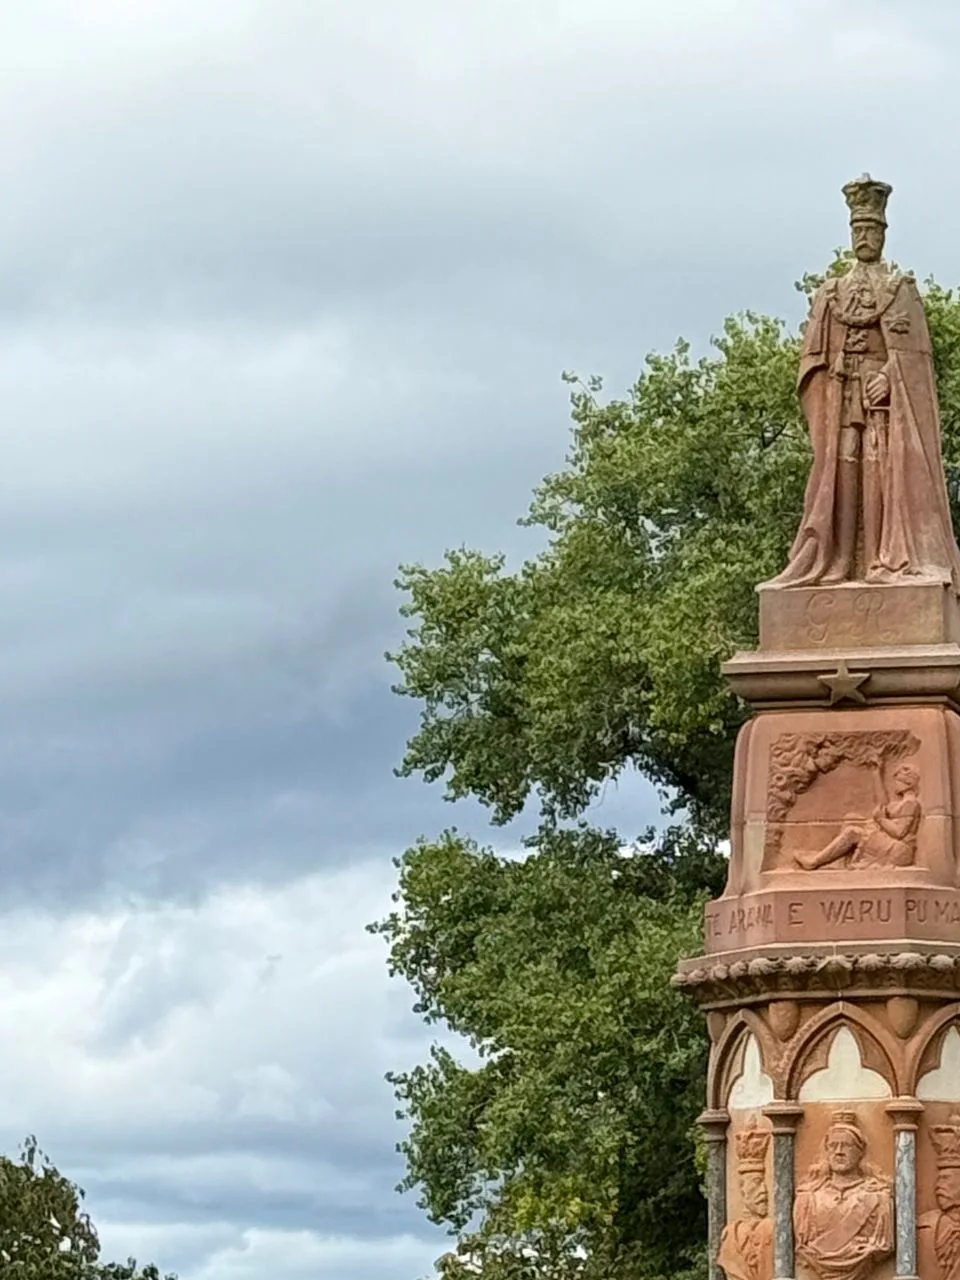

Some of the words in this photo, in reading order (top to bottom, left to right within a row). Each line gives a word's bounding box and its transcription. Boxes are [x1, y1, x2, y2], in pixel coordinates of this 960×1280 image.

[788, 902, 804, 925] E
[820, 900, 892, 924] WARU
[904, 899, 928, 924] PU
